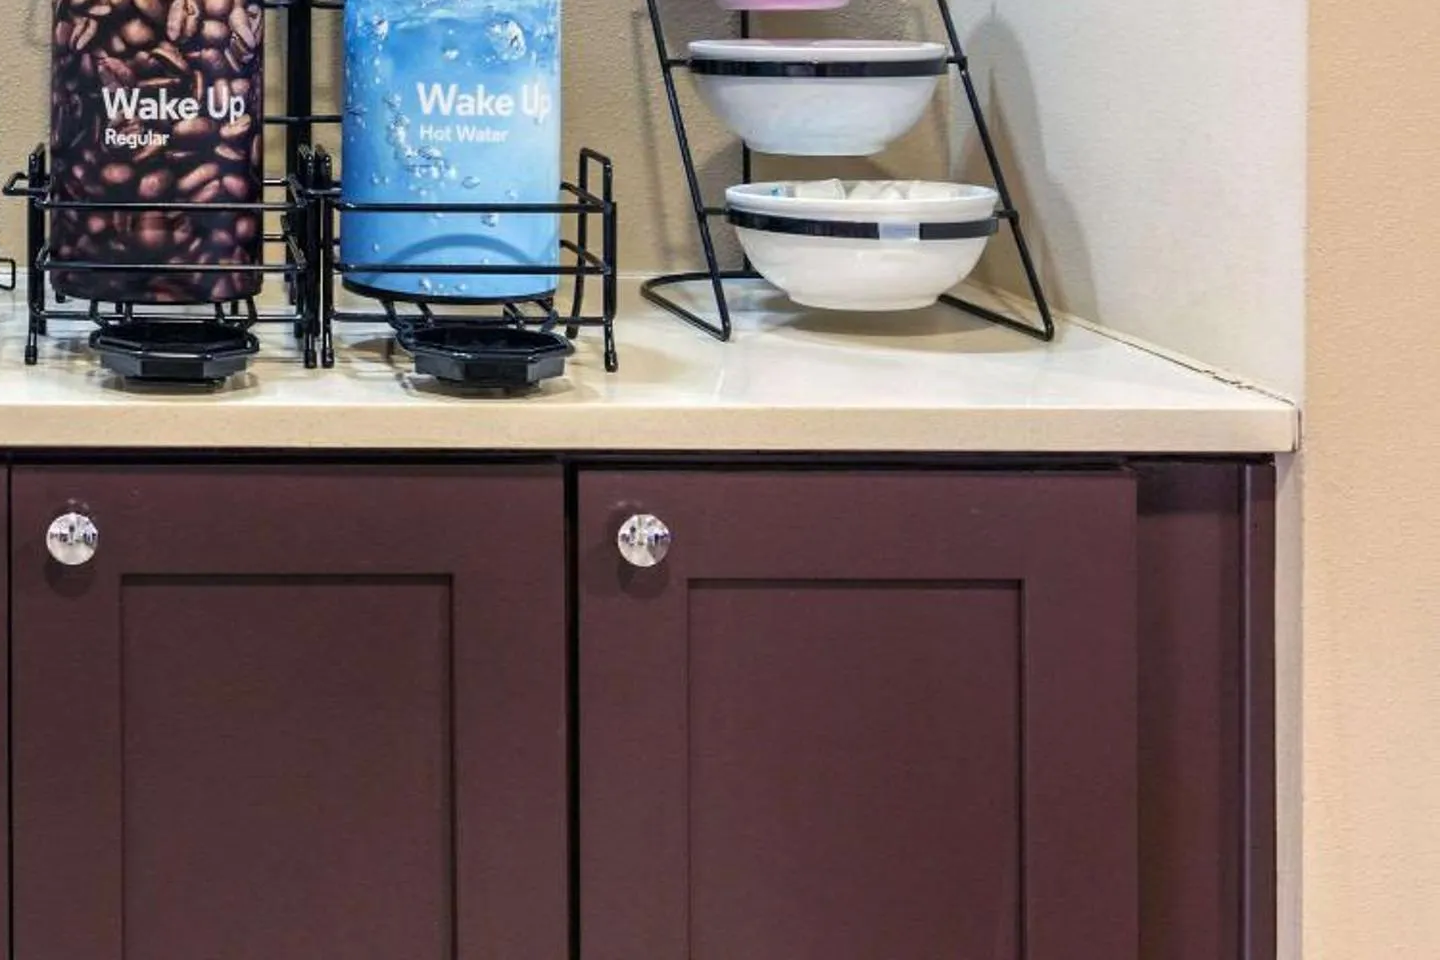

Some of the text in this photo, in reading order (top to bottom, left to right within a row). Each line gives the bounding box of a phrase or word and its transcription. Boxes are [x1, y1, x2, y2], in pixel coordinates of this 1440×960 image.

[102, 86, 246, 125] Wake Up
[416, 82, 552, 124] Wake Up
[104, 128, 170, 149] Regular
[419, 124, 509, 143] Hot Water
